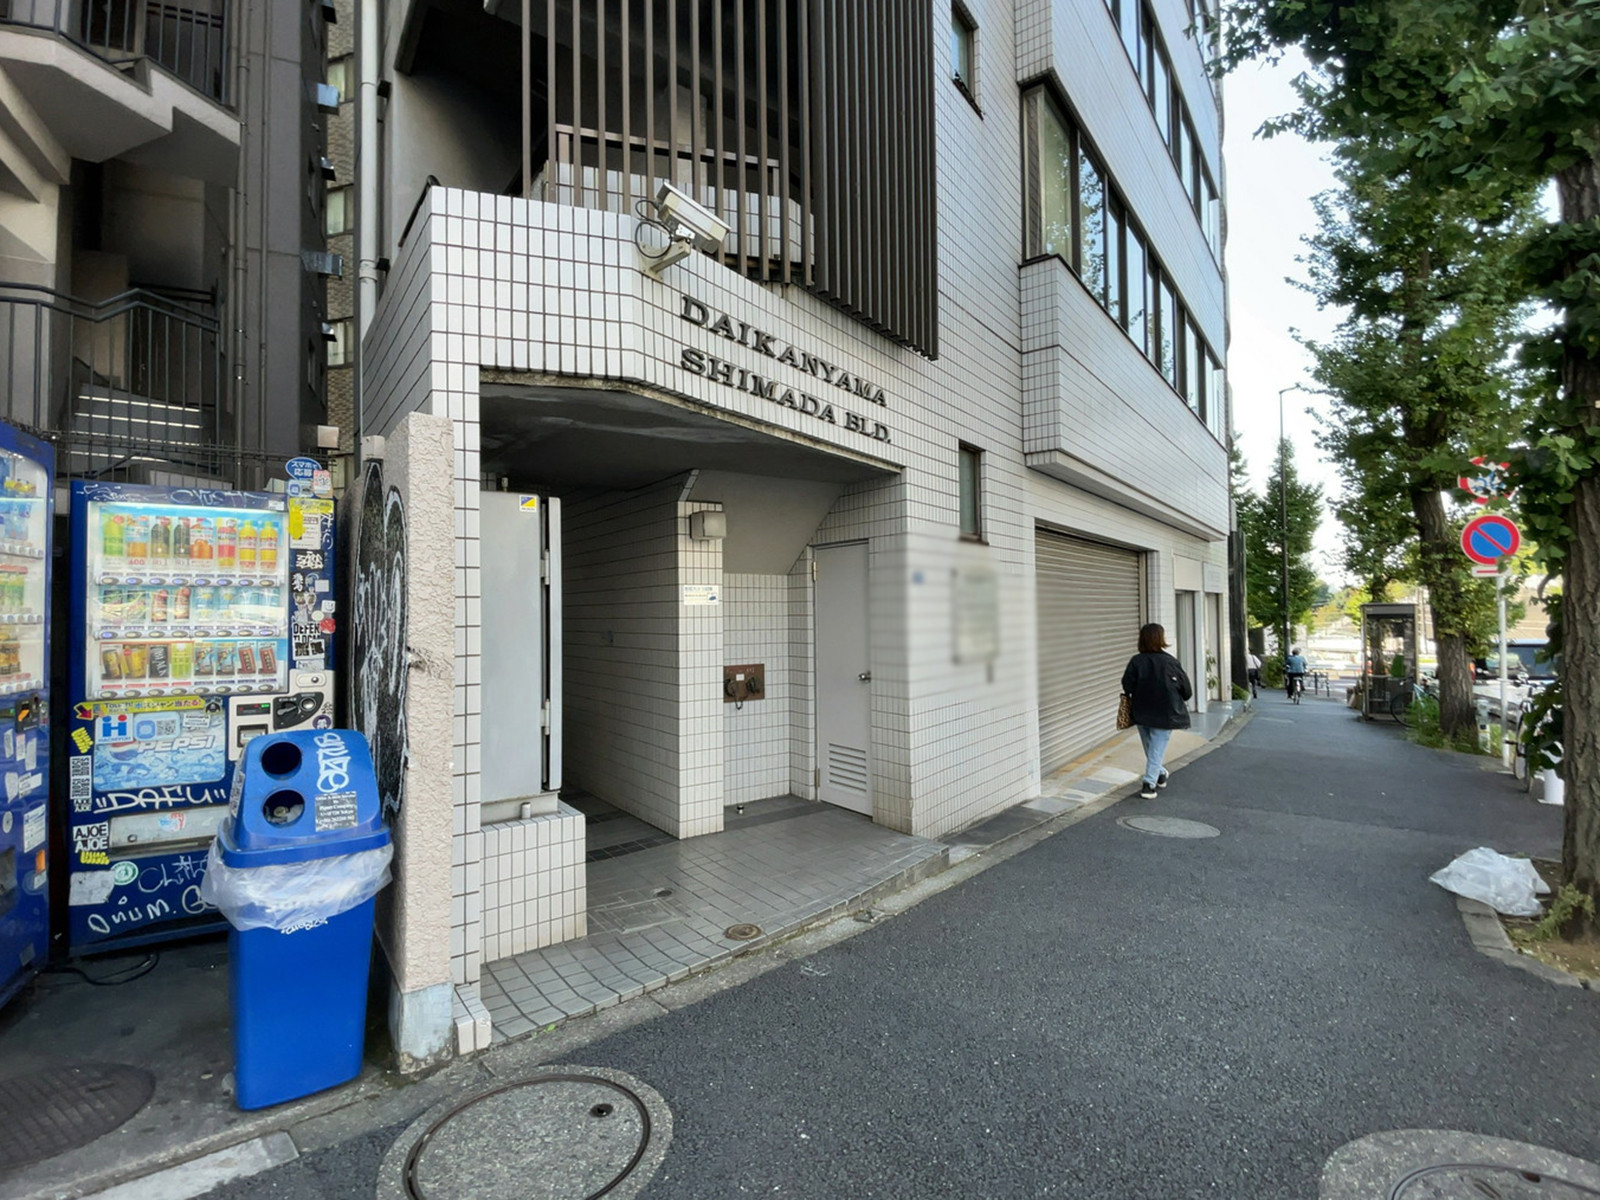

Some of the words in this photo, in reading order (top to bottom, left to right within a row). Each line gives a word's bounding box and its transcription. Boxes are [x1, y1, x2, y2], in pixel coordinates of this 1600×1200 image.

[680, 295, 888, 408] DAIKANYAMA
[680, 347, 837, 425] SHIMADA
[843, 411, 892, 444] BLD.
[137, 735, 216, 754] PEPSI
[74, 823, 107, 840] AJOE
[74, 837, 108, 854] AJOE
